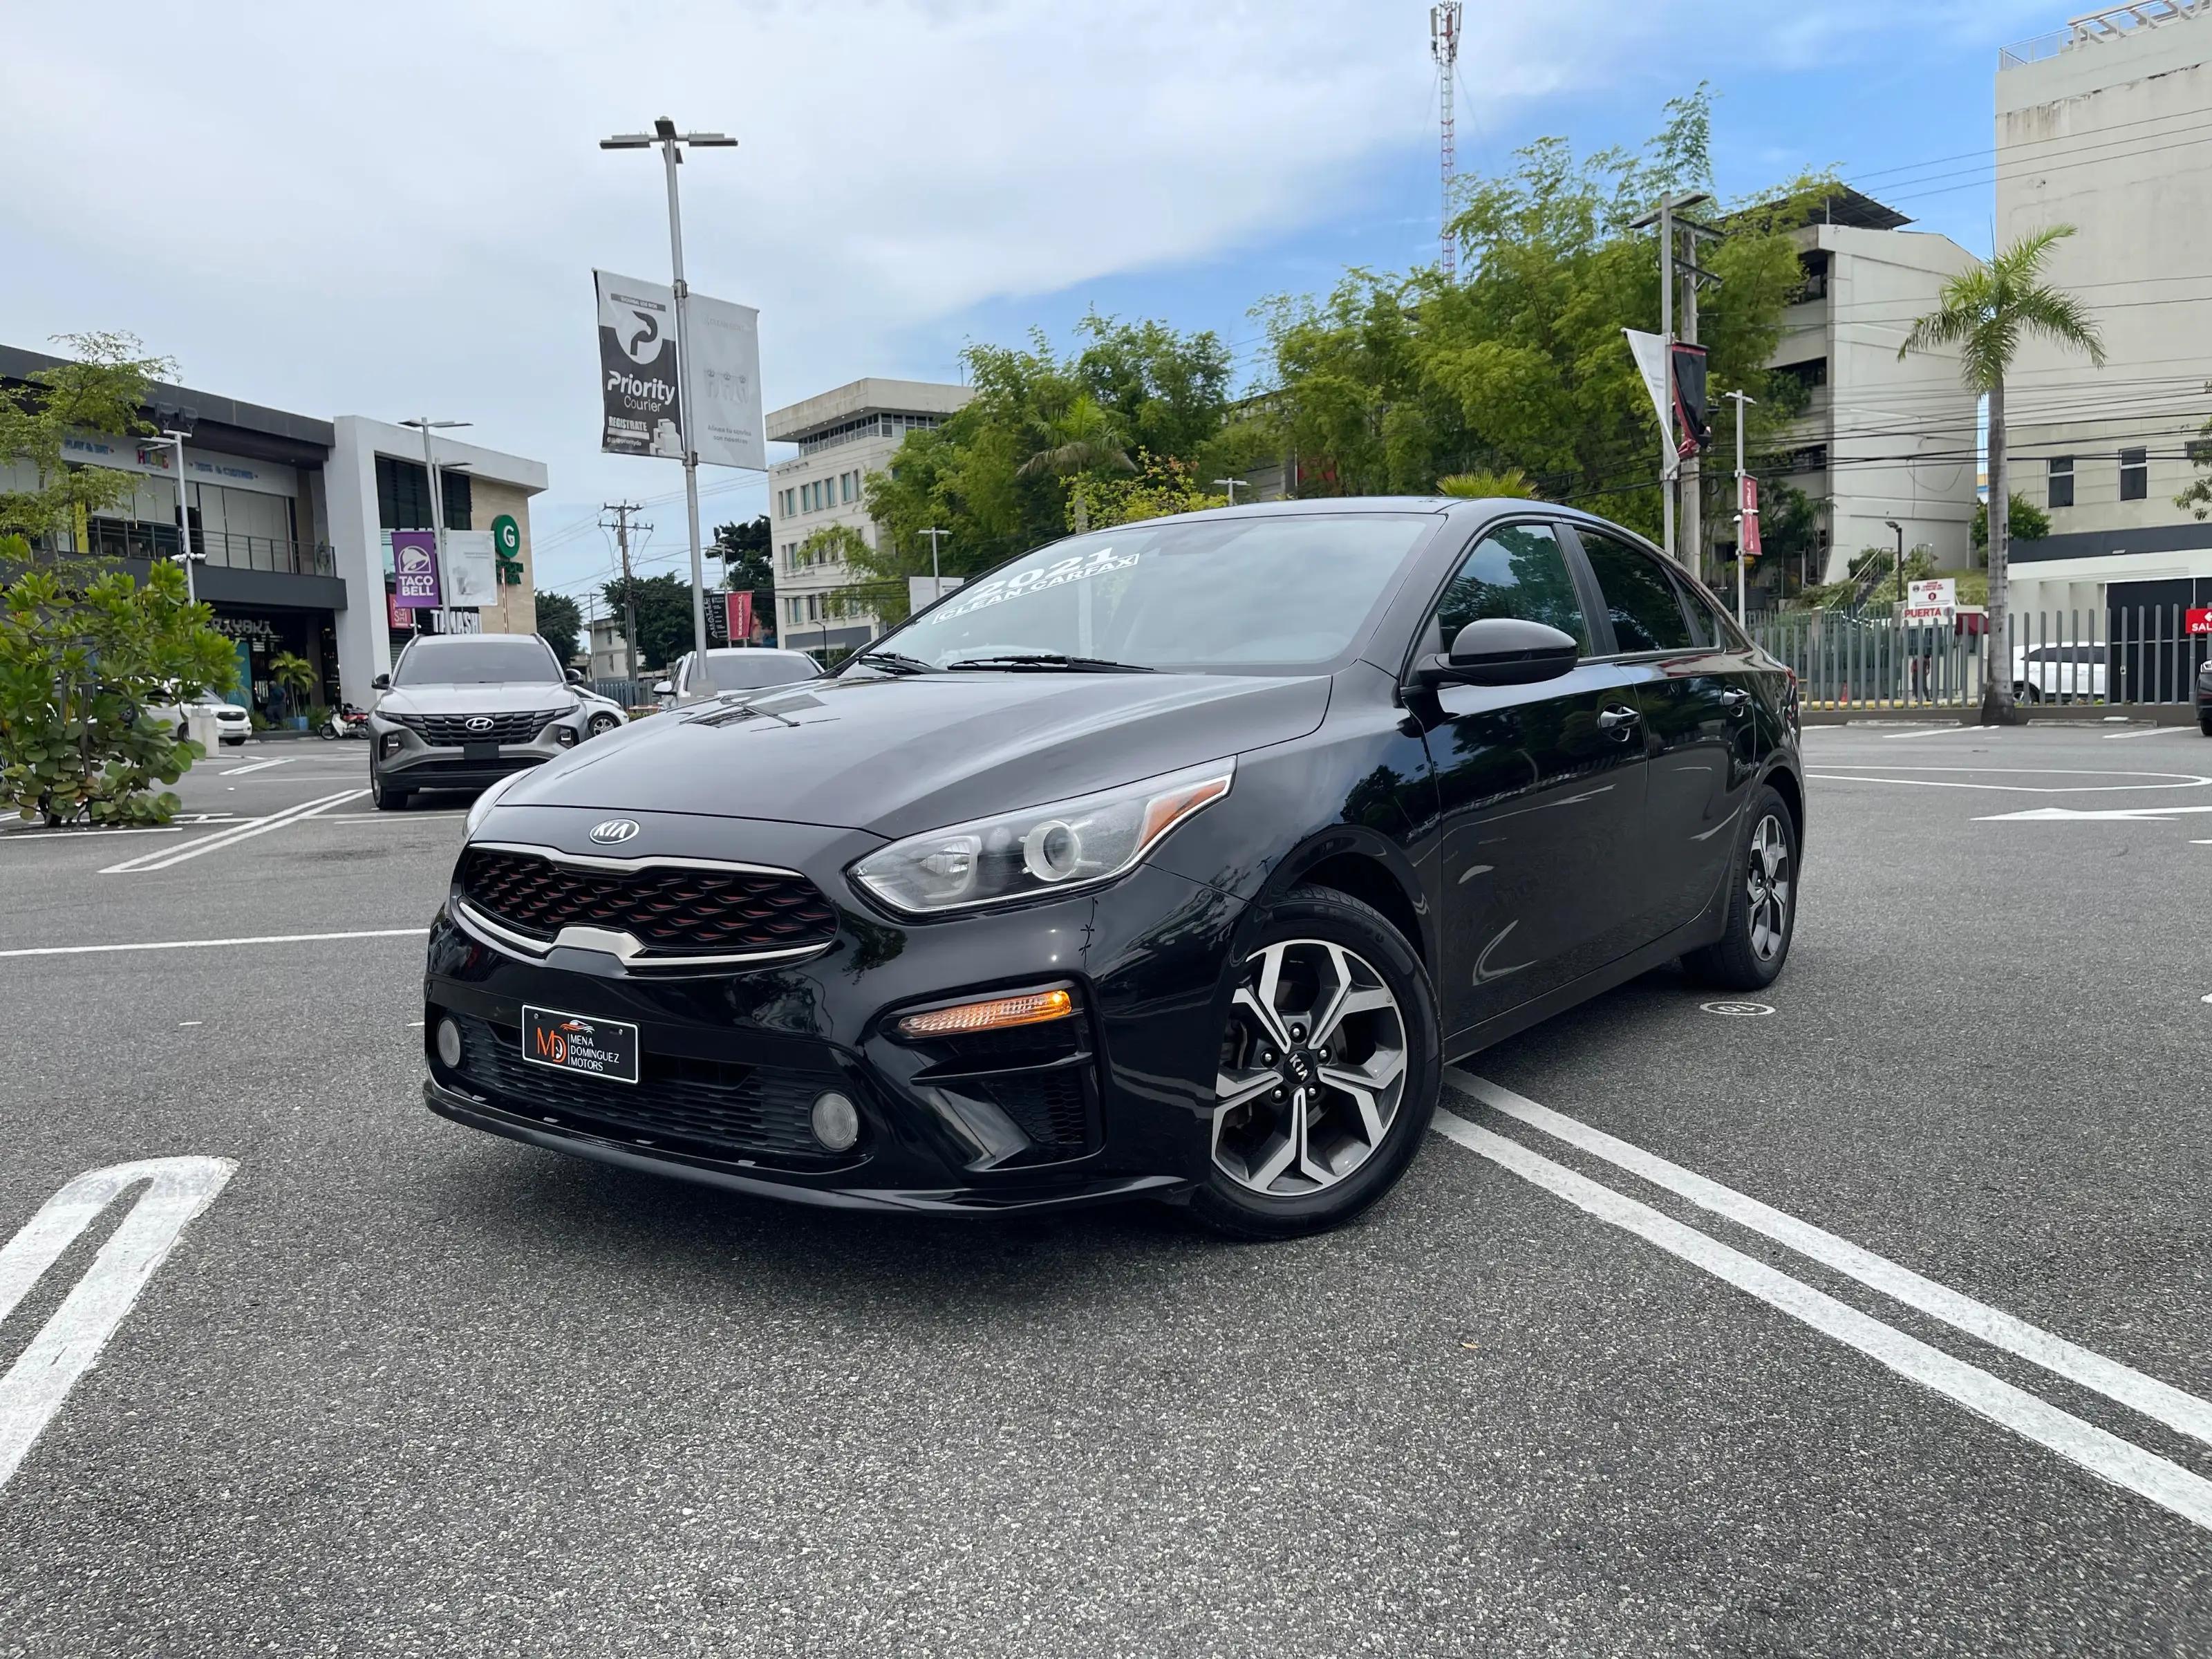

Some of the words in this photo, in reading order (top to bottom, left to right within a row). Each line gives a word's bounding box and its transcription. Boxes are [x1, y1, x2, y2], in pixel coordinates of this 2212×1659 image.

[608, 370, 675, 405] Priority
[624, 395, 661, 412] Courier
[399, 575, 433, 586] TACO
[968, 547, 1119, 603] 2021
[402, 586, 434, 596] BELL
[939, 587, 1024, 621] CLEAN
[1030, 556, 1135, 591] CARFAX
[1904, 608, 1942, 617] PUERTA
[593, 822, 630, 838] KIA
[570, 1034, 594, 1047] MENA
[570, 1045, 620, 1064] DOMINGUEZ
[570, 1058, 603, 1071] MOTORS
[1289, 1053, 1308, 1081] KIA
